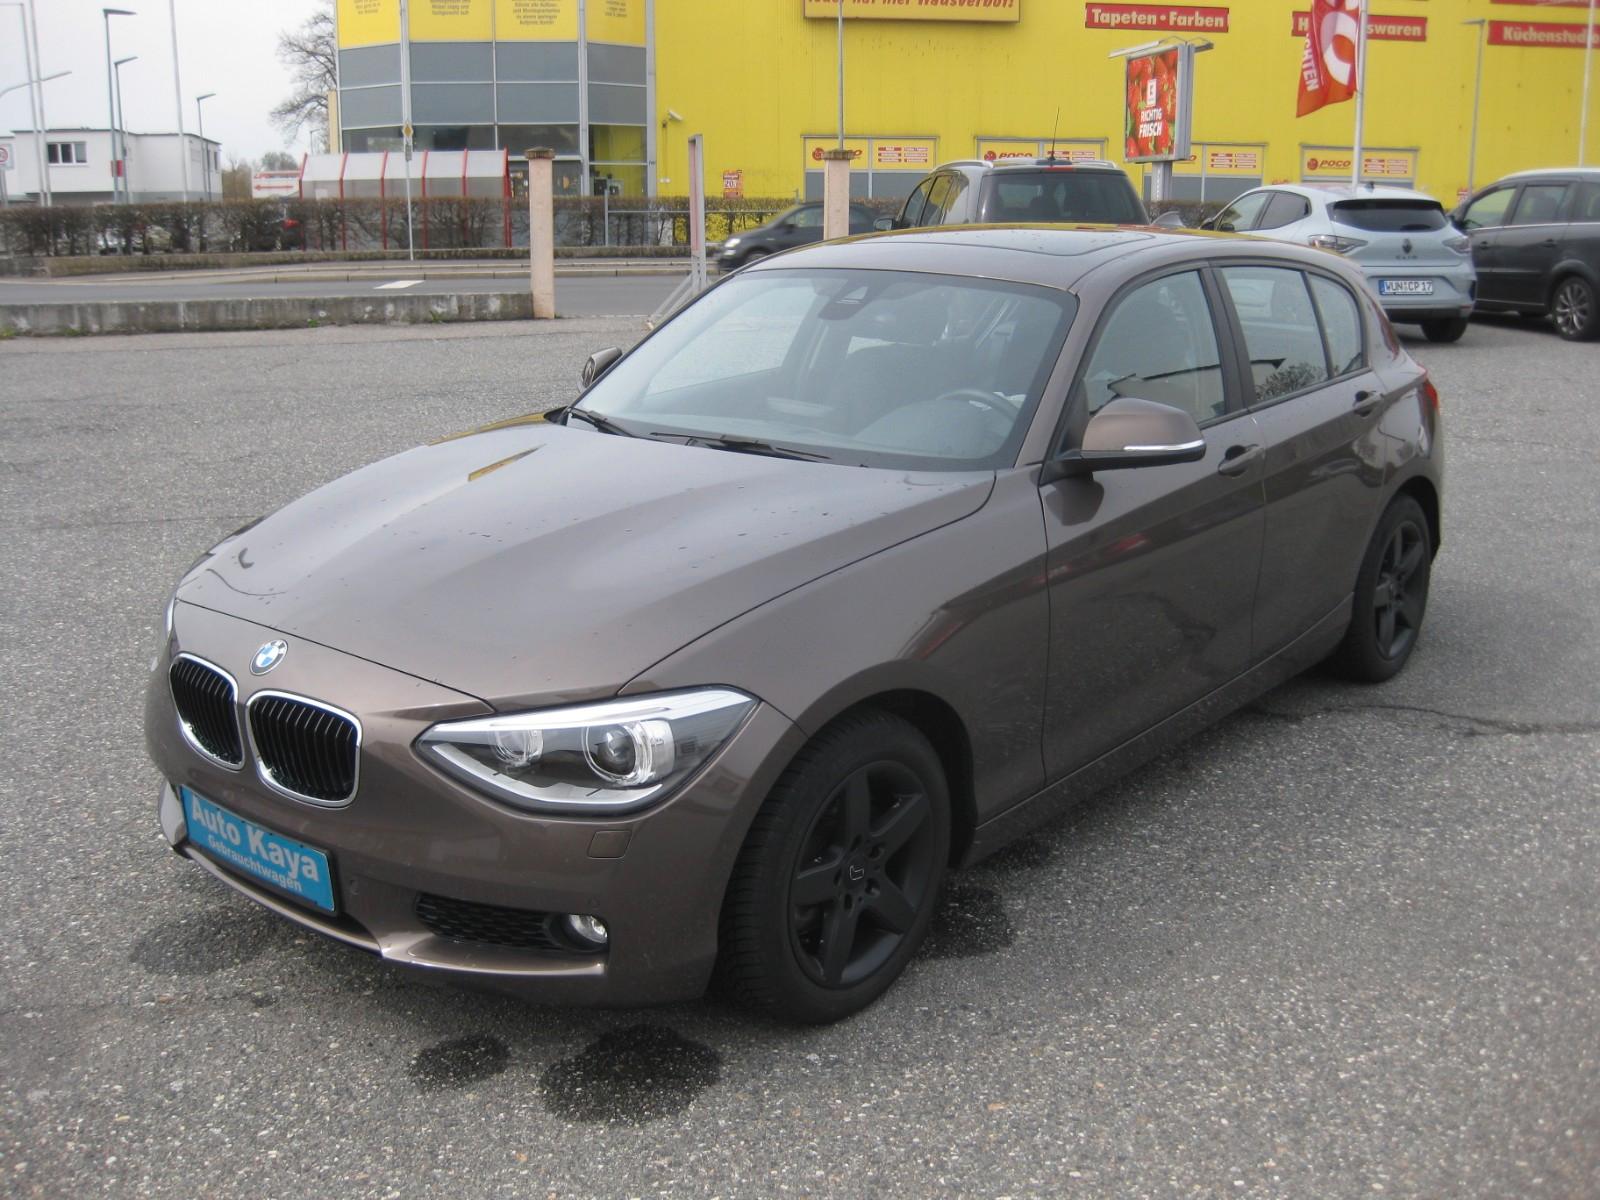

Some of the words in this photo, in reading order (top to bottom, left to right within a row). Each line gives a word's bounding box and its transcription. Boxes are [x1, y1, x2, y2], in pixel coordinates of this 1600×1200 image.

[1091, 8, 1157, 27] Tapeten
[1168, 10, 1224, 28] Farben
[1140, 107, 1163, 123] RICHTIG
[1138, 121, 1163, 138] FRISCH
[1319, 159, 1351, 168] POCO
[192, 793, 241, 846] Auto
[246, 824, 320, 882] Kaya
[207, 834, 303, 893] Gebrauchtwagen
